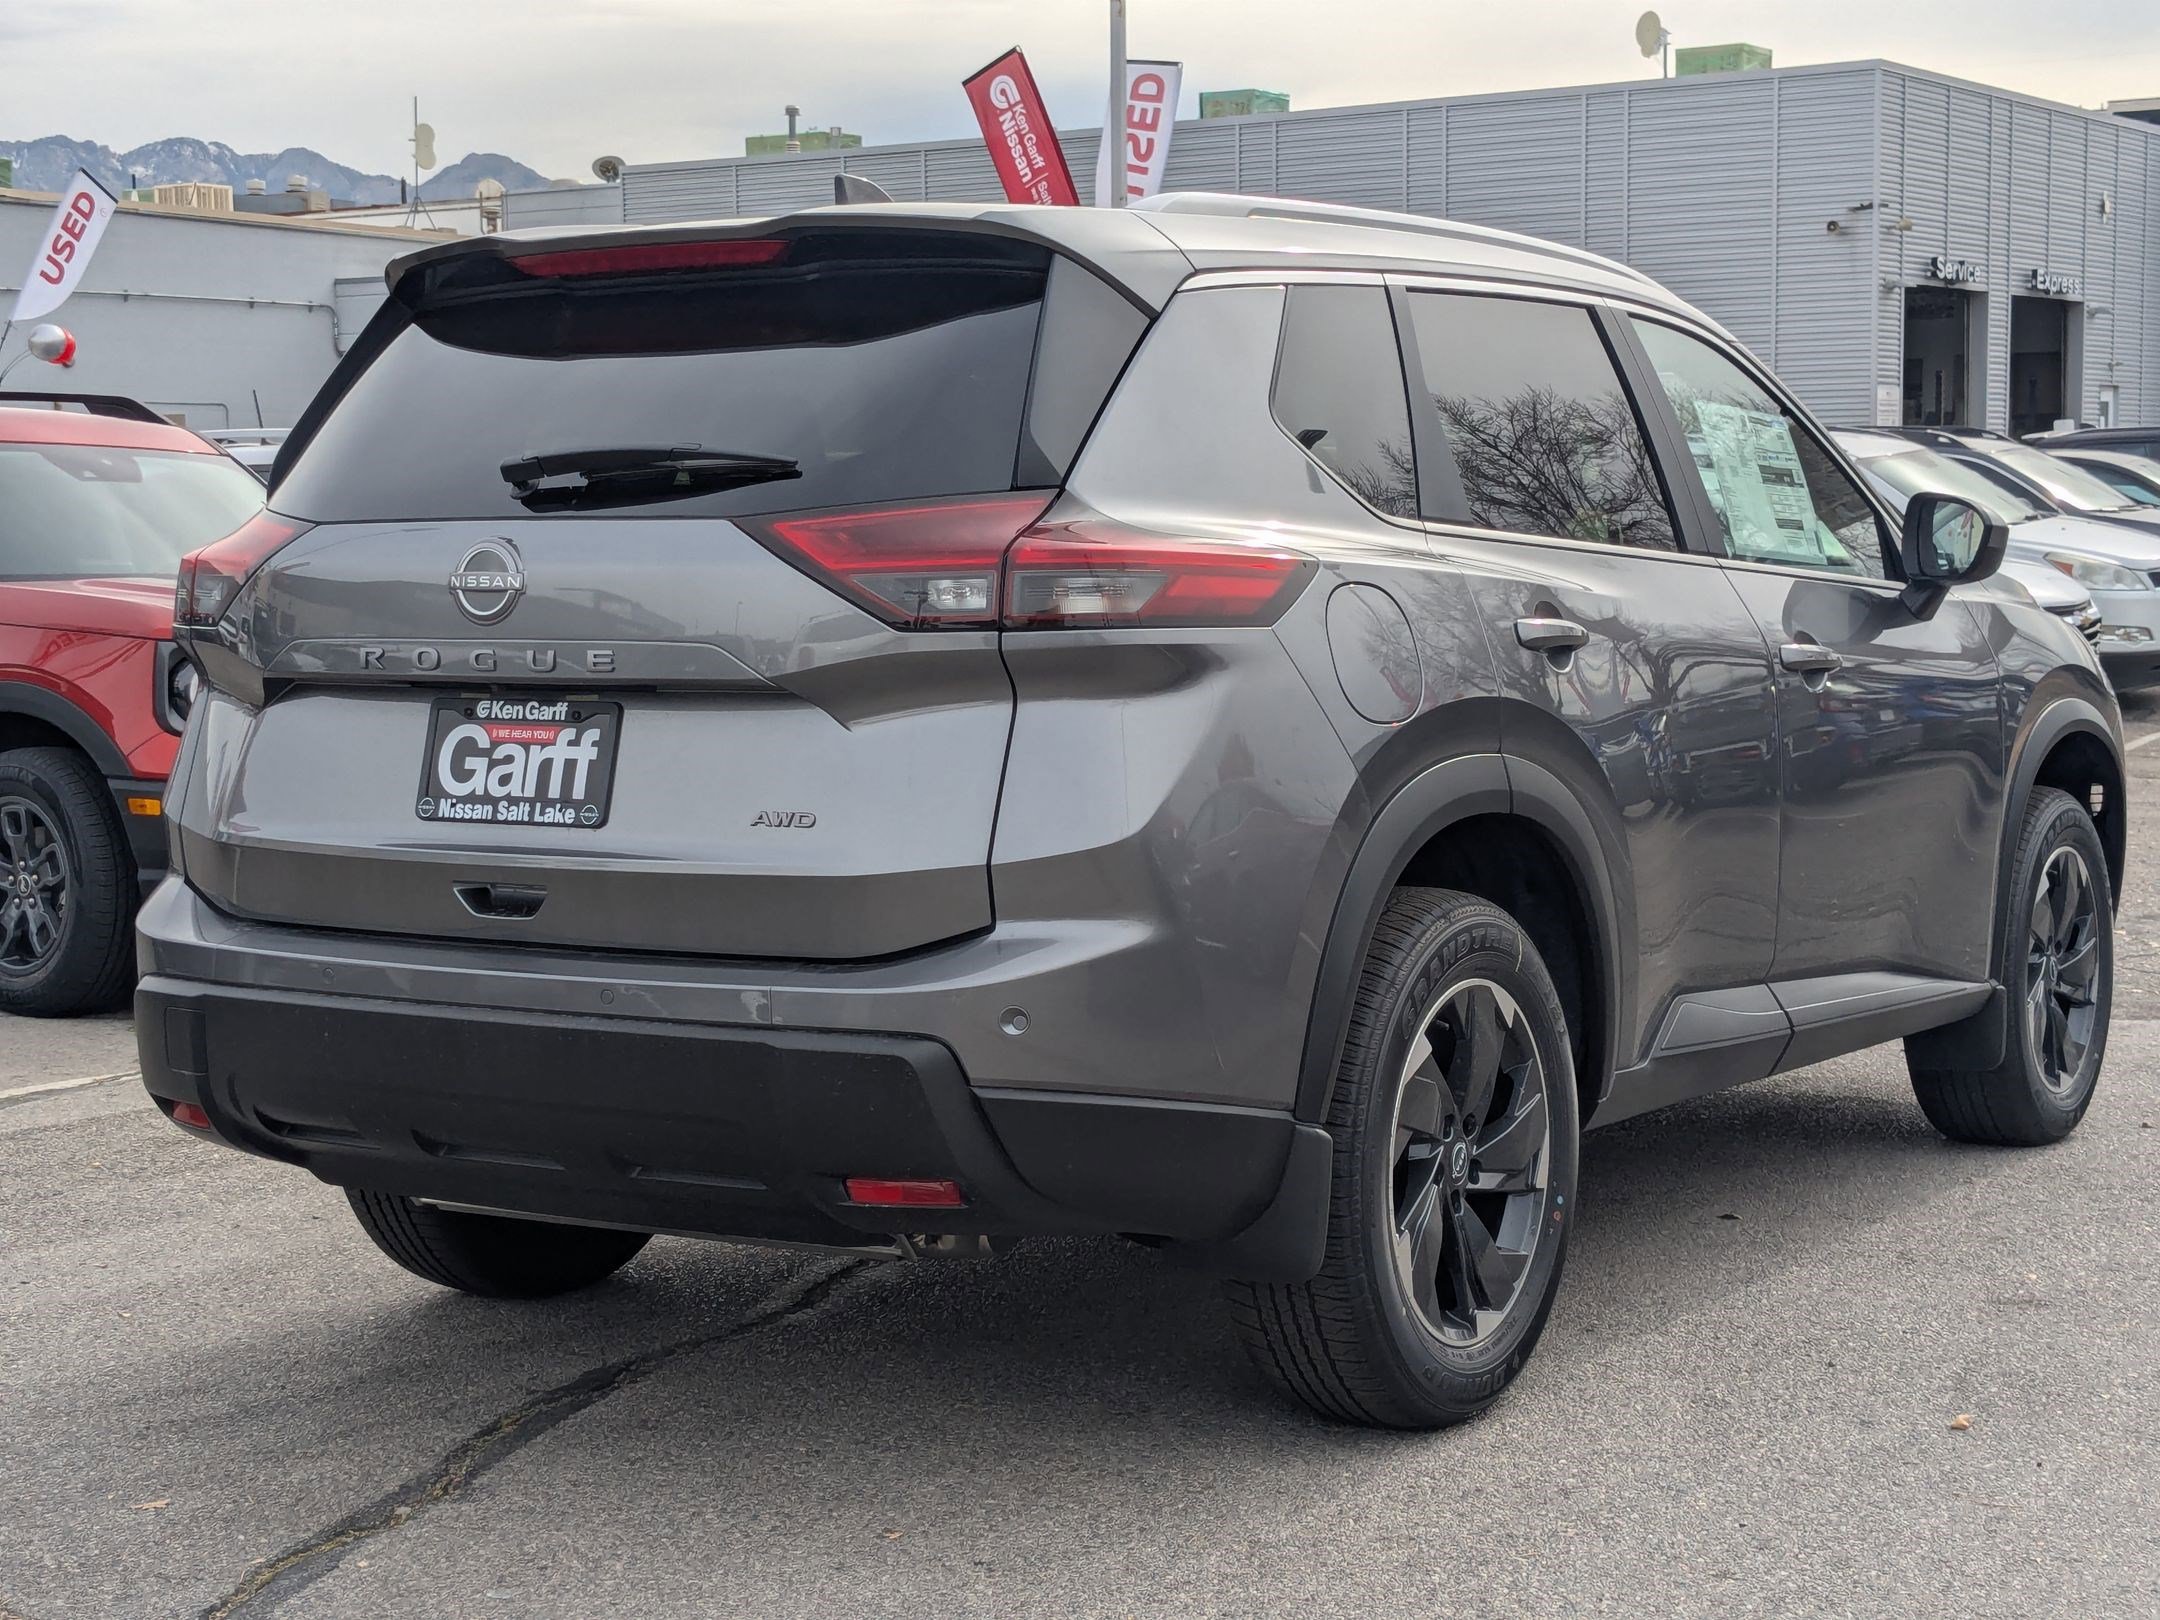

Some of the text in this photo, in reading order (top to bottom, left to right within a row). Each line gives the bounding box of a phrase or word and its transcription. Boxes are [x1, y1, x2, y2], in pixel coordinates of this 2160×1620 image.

[999, 111, 1032, 183] Nissan
[1013, 103, 1029, 135] Ken
[1023, 133, 1046, 169] Garff
[39, 191, 96, 285] USED
[1935, 255, 1982, 283] Service
[2036, 269, 2081, 296] Express
[450, 574, 521, 588] NISSAN
[359, 647, 616, 673] ROGUE
[491, 700, 524, 719] Ken
[525, 701, 568, 721] Garff
[498, 728, 550, 740] WE HEAR YOU
[438, 723, 600, 800] Garff
[438, 798, 576, 825] Nissan Salt Lake
[750, 811, 817, 828] AWD
